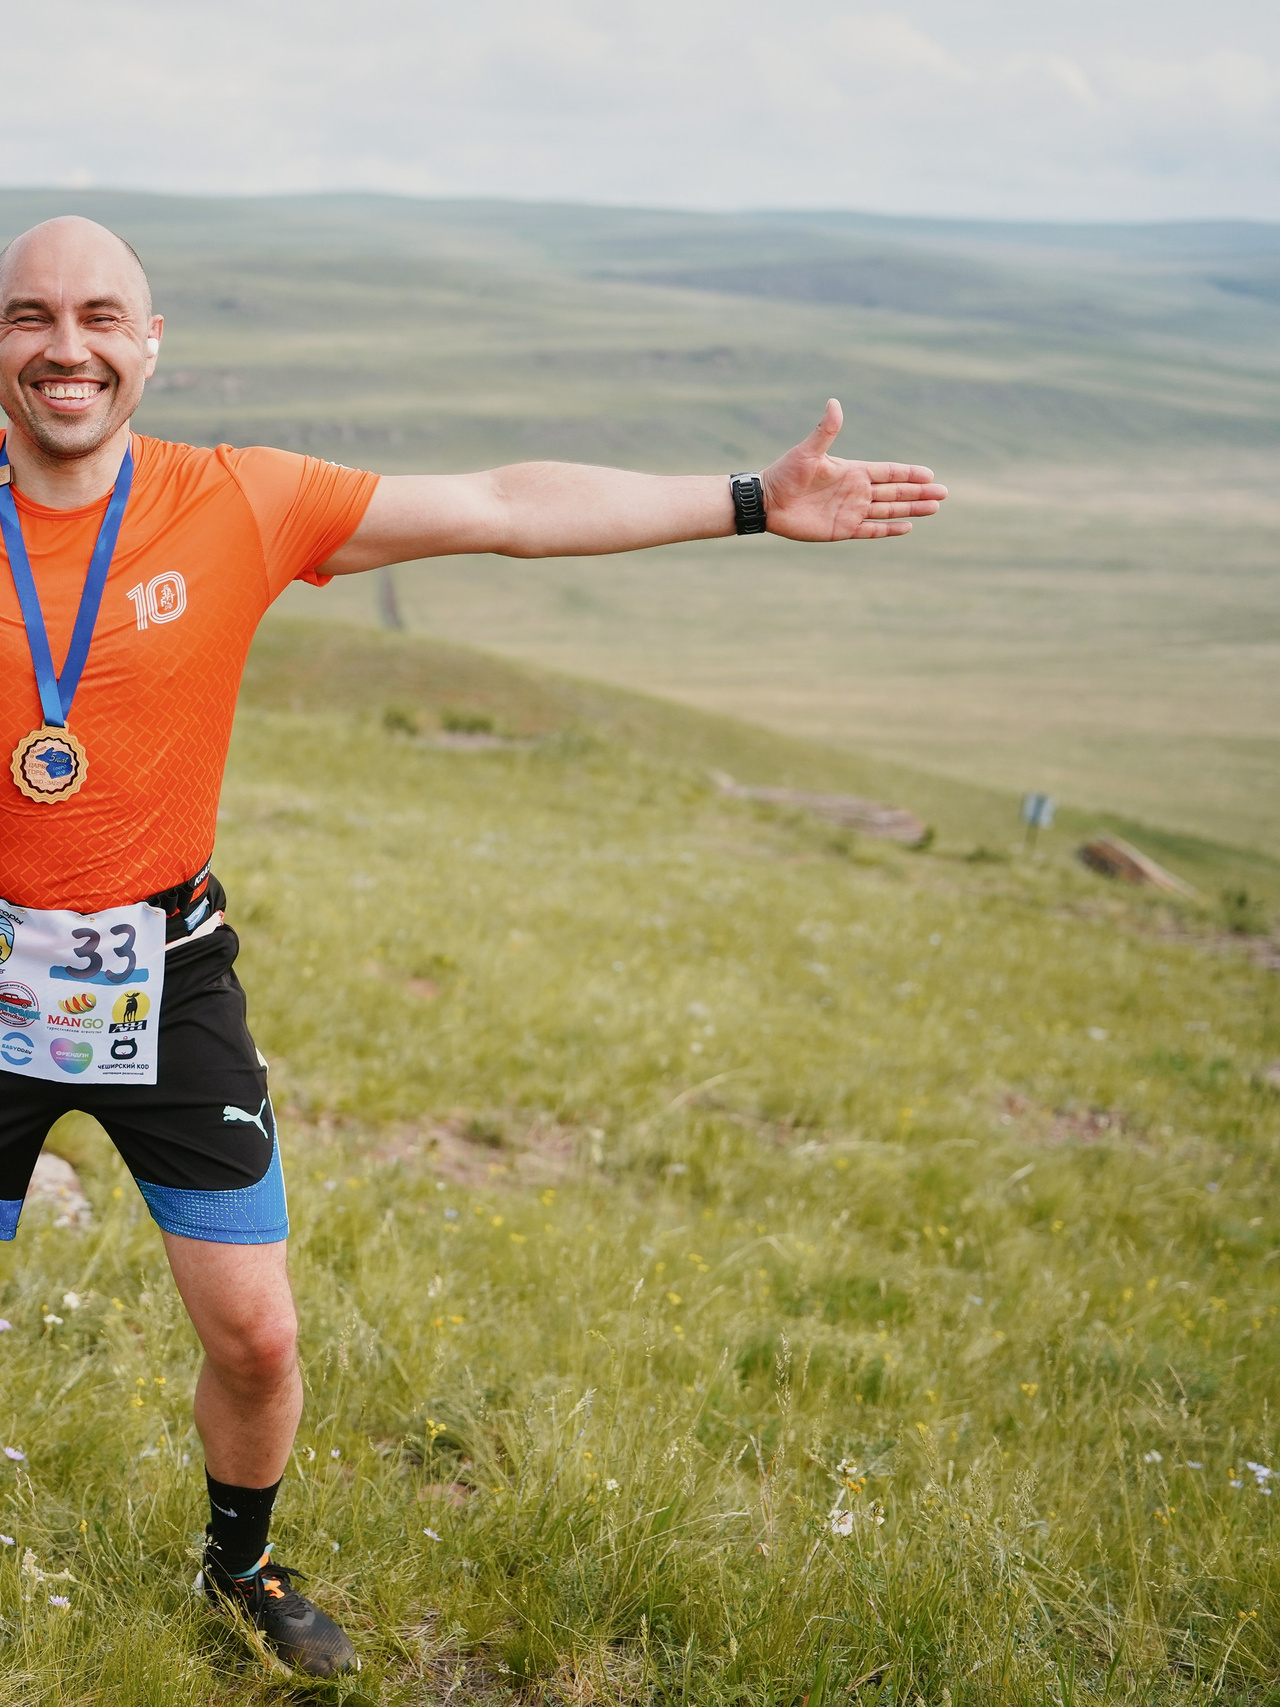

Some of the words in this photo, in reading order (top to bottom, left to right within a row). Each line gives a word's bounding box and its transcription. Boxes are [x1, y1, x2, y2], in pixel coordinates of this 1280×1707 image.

[126, 571, 187, 631] 10
[65, 923, 136, 983] 33
[47, 1014, 104, 1029] MANGO
[97, 1062, 136, 1070] ЧЕШИРСКИЙ
